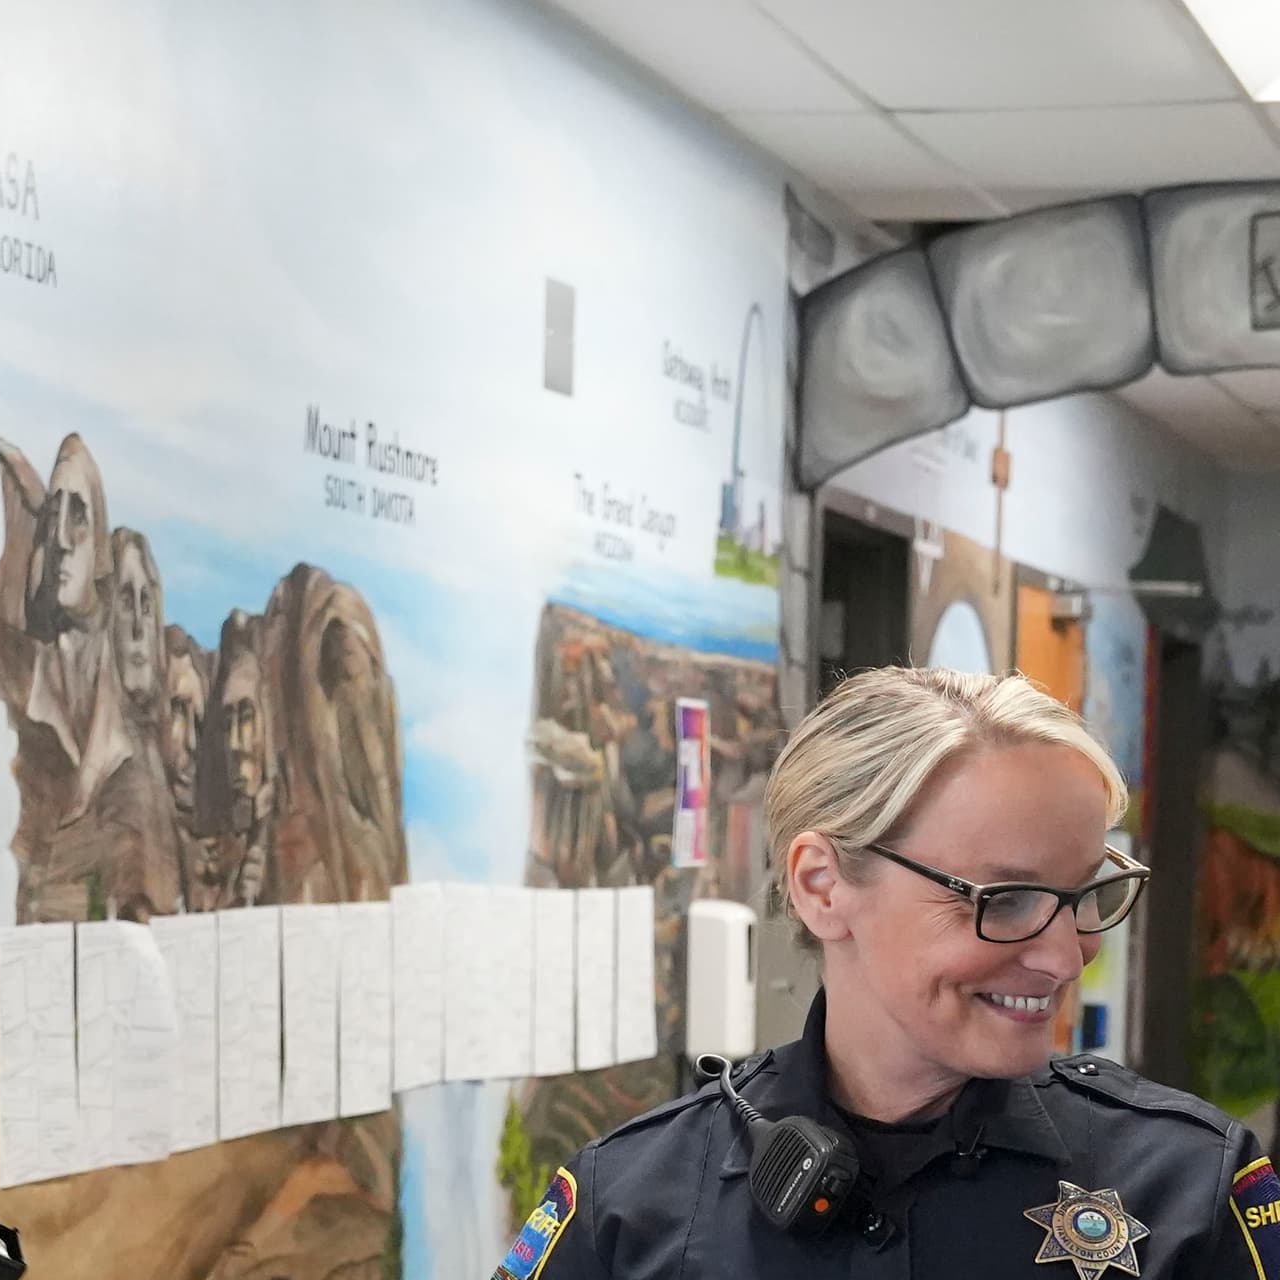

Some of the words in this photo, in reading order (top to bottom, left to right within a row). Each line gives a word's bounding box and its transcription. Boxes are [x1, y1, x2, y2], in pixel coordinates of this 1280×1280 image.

[303, 402, 358, 464] Mount
[365, 420, 439, 487] Rushmore
[323, 473, 366, 515] SOUTH
[371, 485, 417, 528] DAKOTA
[1054, 1225, 1094, 1259] HAMILTON
[1095, 1233, 1126, 1260] COUNTY
